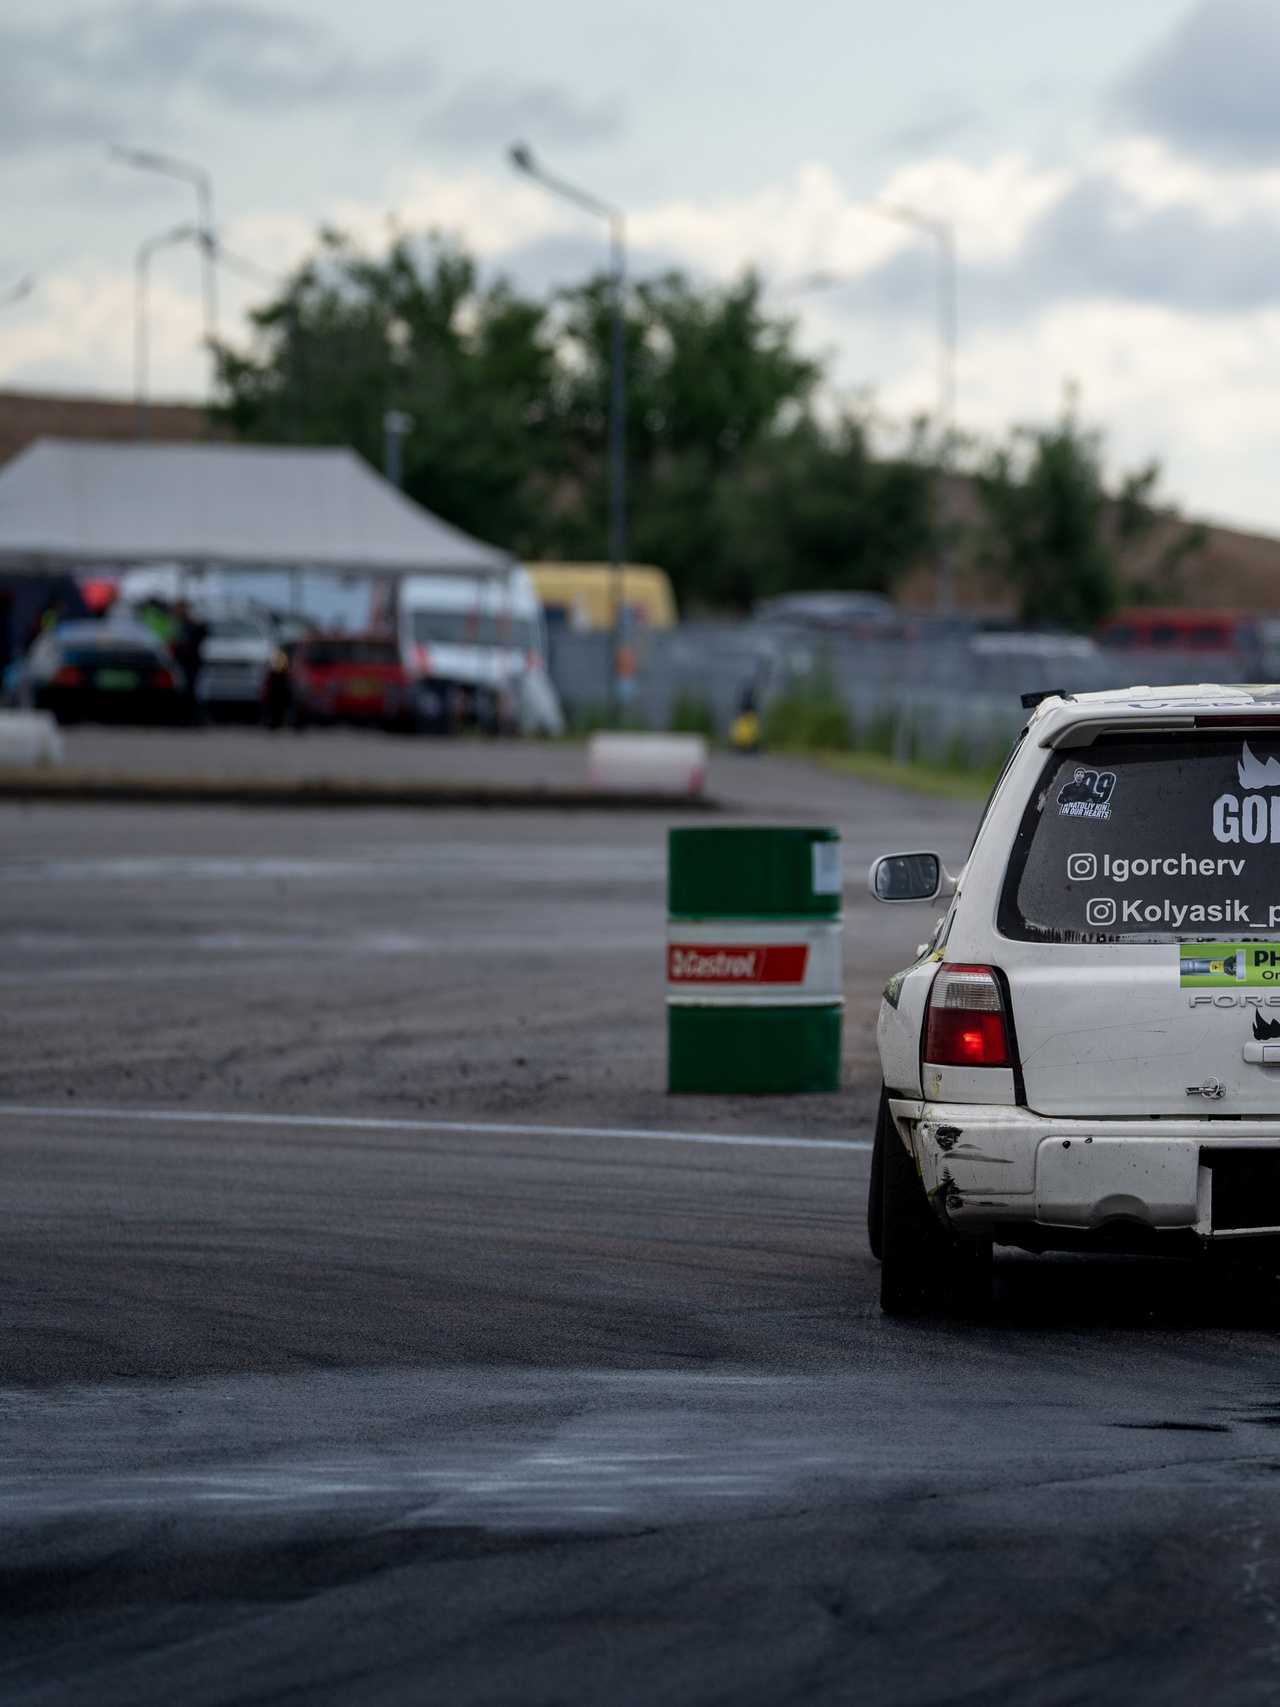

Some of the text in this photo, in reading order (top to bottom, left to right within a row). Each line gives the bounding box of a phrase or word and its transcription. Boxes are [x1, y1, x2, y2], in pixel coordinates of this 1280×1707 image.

[1063, 802, 1095, 810] ANATOLIY
[1083, 809, 1110, 819] HEARTS
[1103, 853, 1246, 882] Igorcherv
[683, 949, 757, 978] Castrol
